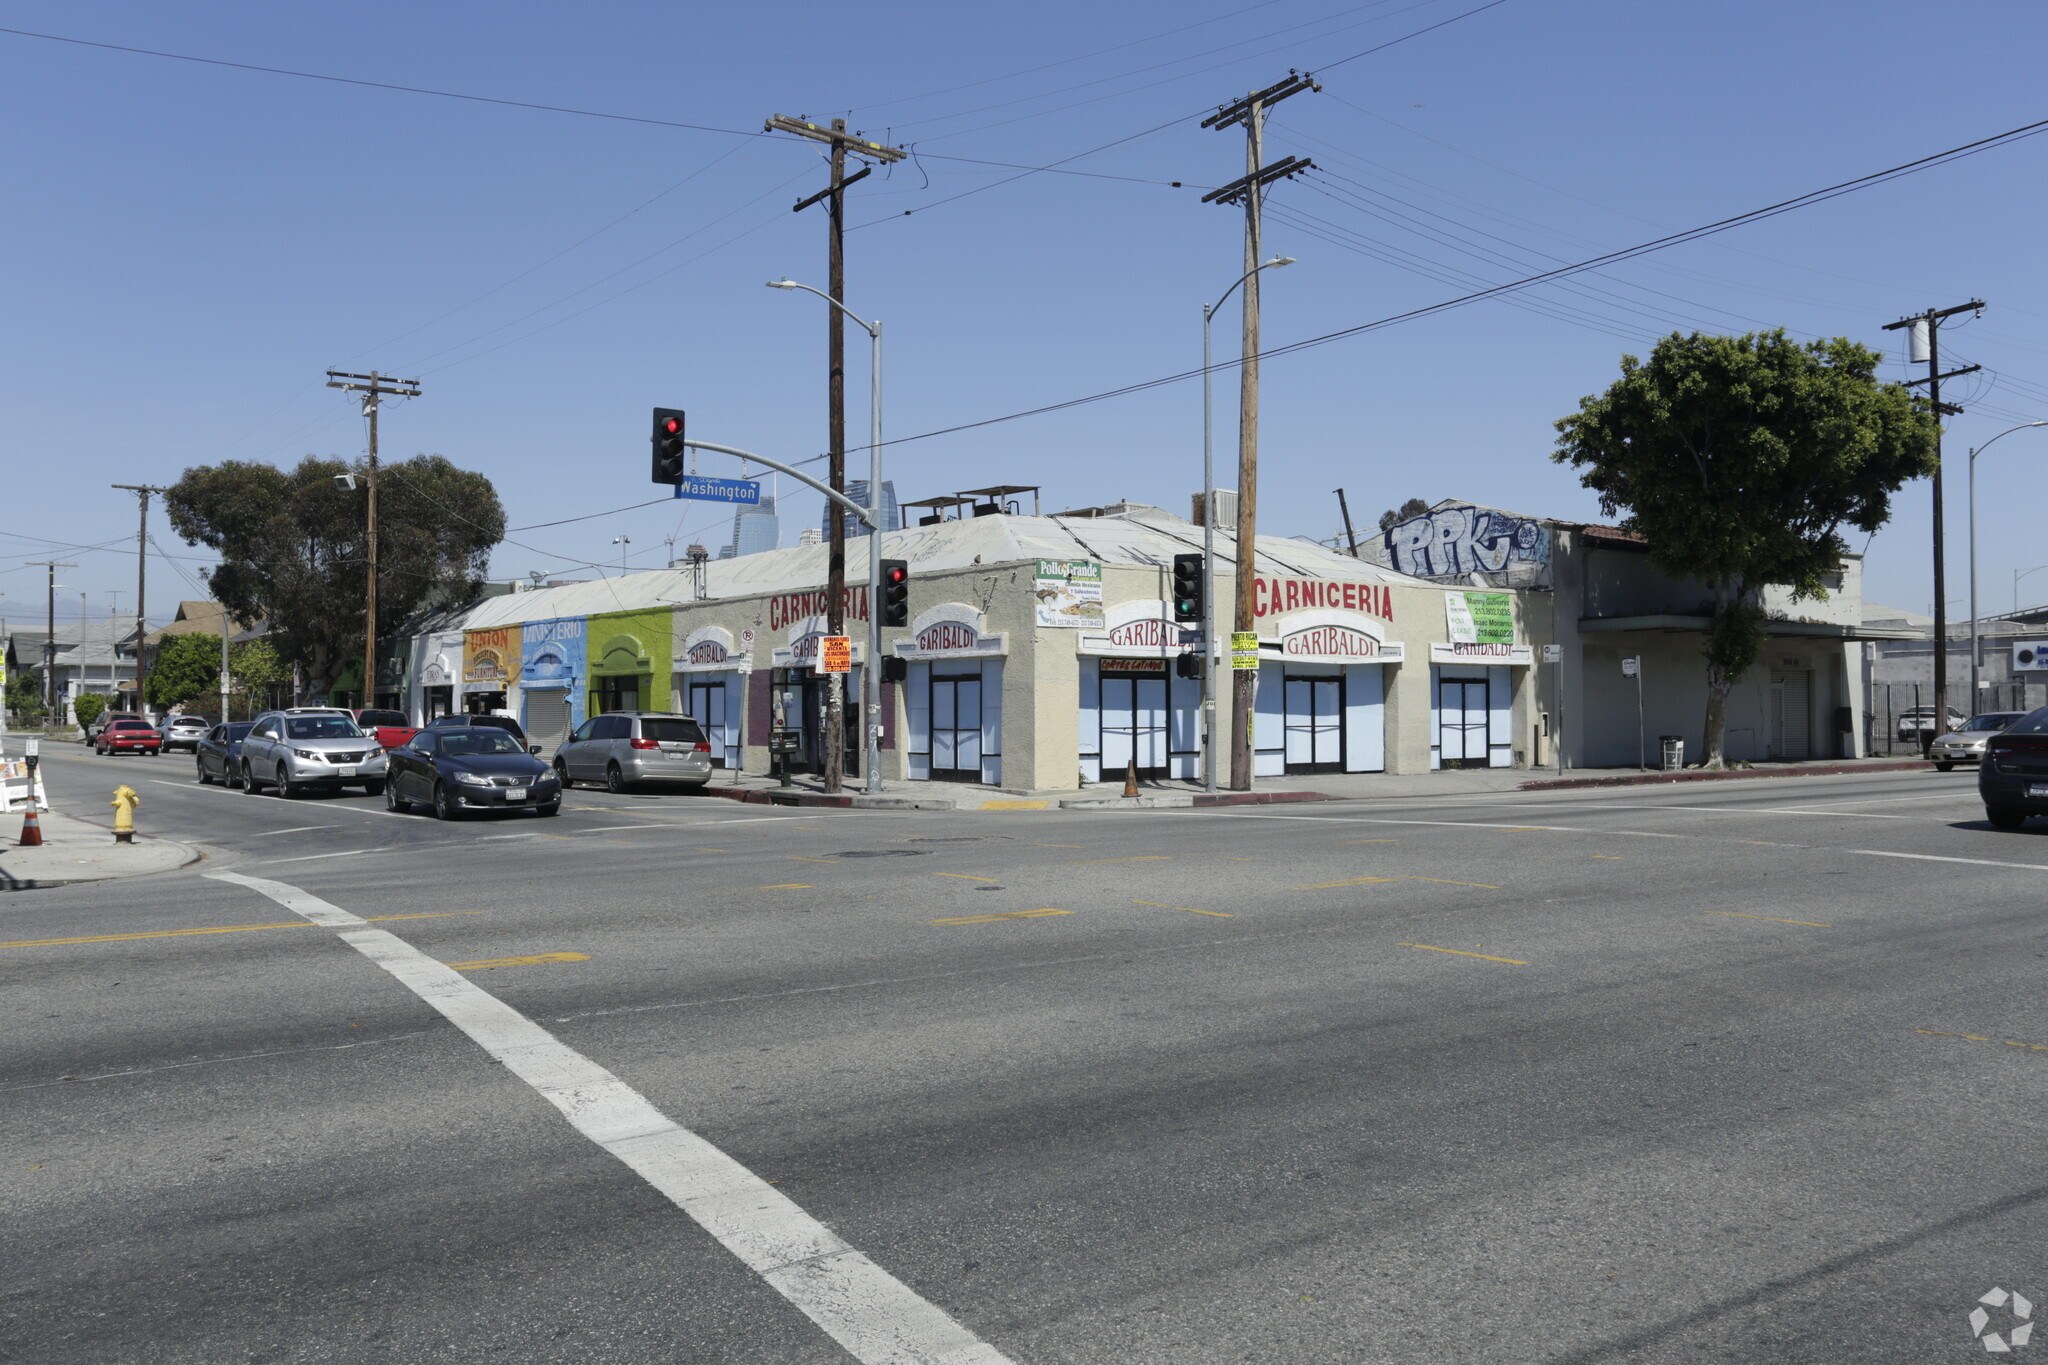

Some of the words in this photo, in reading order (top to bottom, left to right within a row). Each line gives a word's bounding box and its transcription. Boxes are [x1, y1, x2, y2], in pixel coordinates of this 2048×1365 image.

[681, 480, 755, 501] Washington
[1066, 562, 1098, 577] Grande
[770, 586, 869, 632] CARNICRIA
[1253, 577, 1394, 623] CARNICERIA
[523, 621, 582, 643] MINISTERIO
[920, 625, 973, 651] GARIBALDI
[1110, 619, 1191, 647] GARIBAL
[1287, 626, 1374, 656] GARIBALDI
[690, 644, 728, 665] GARIBALDI
